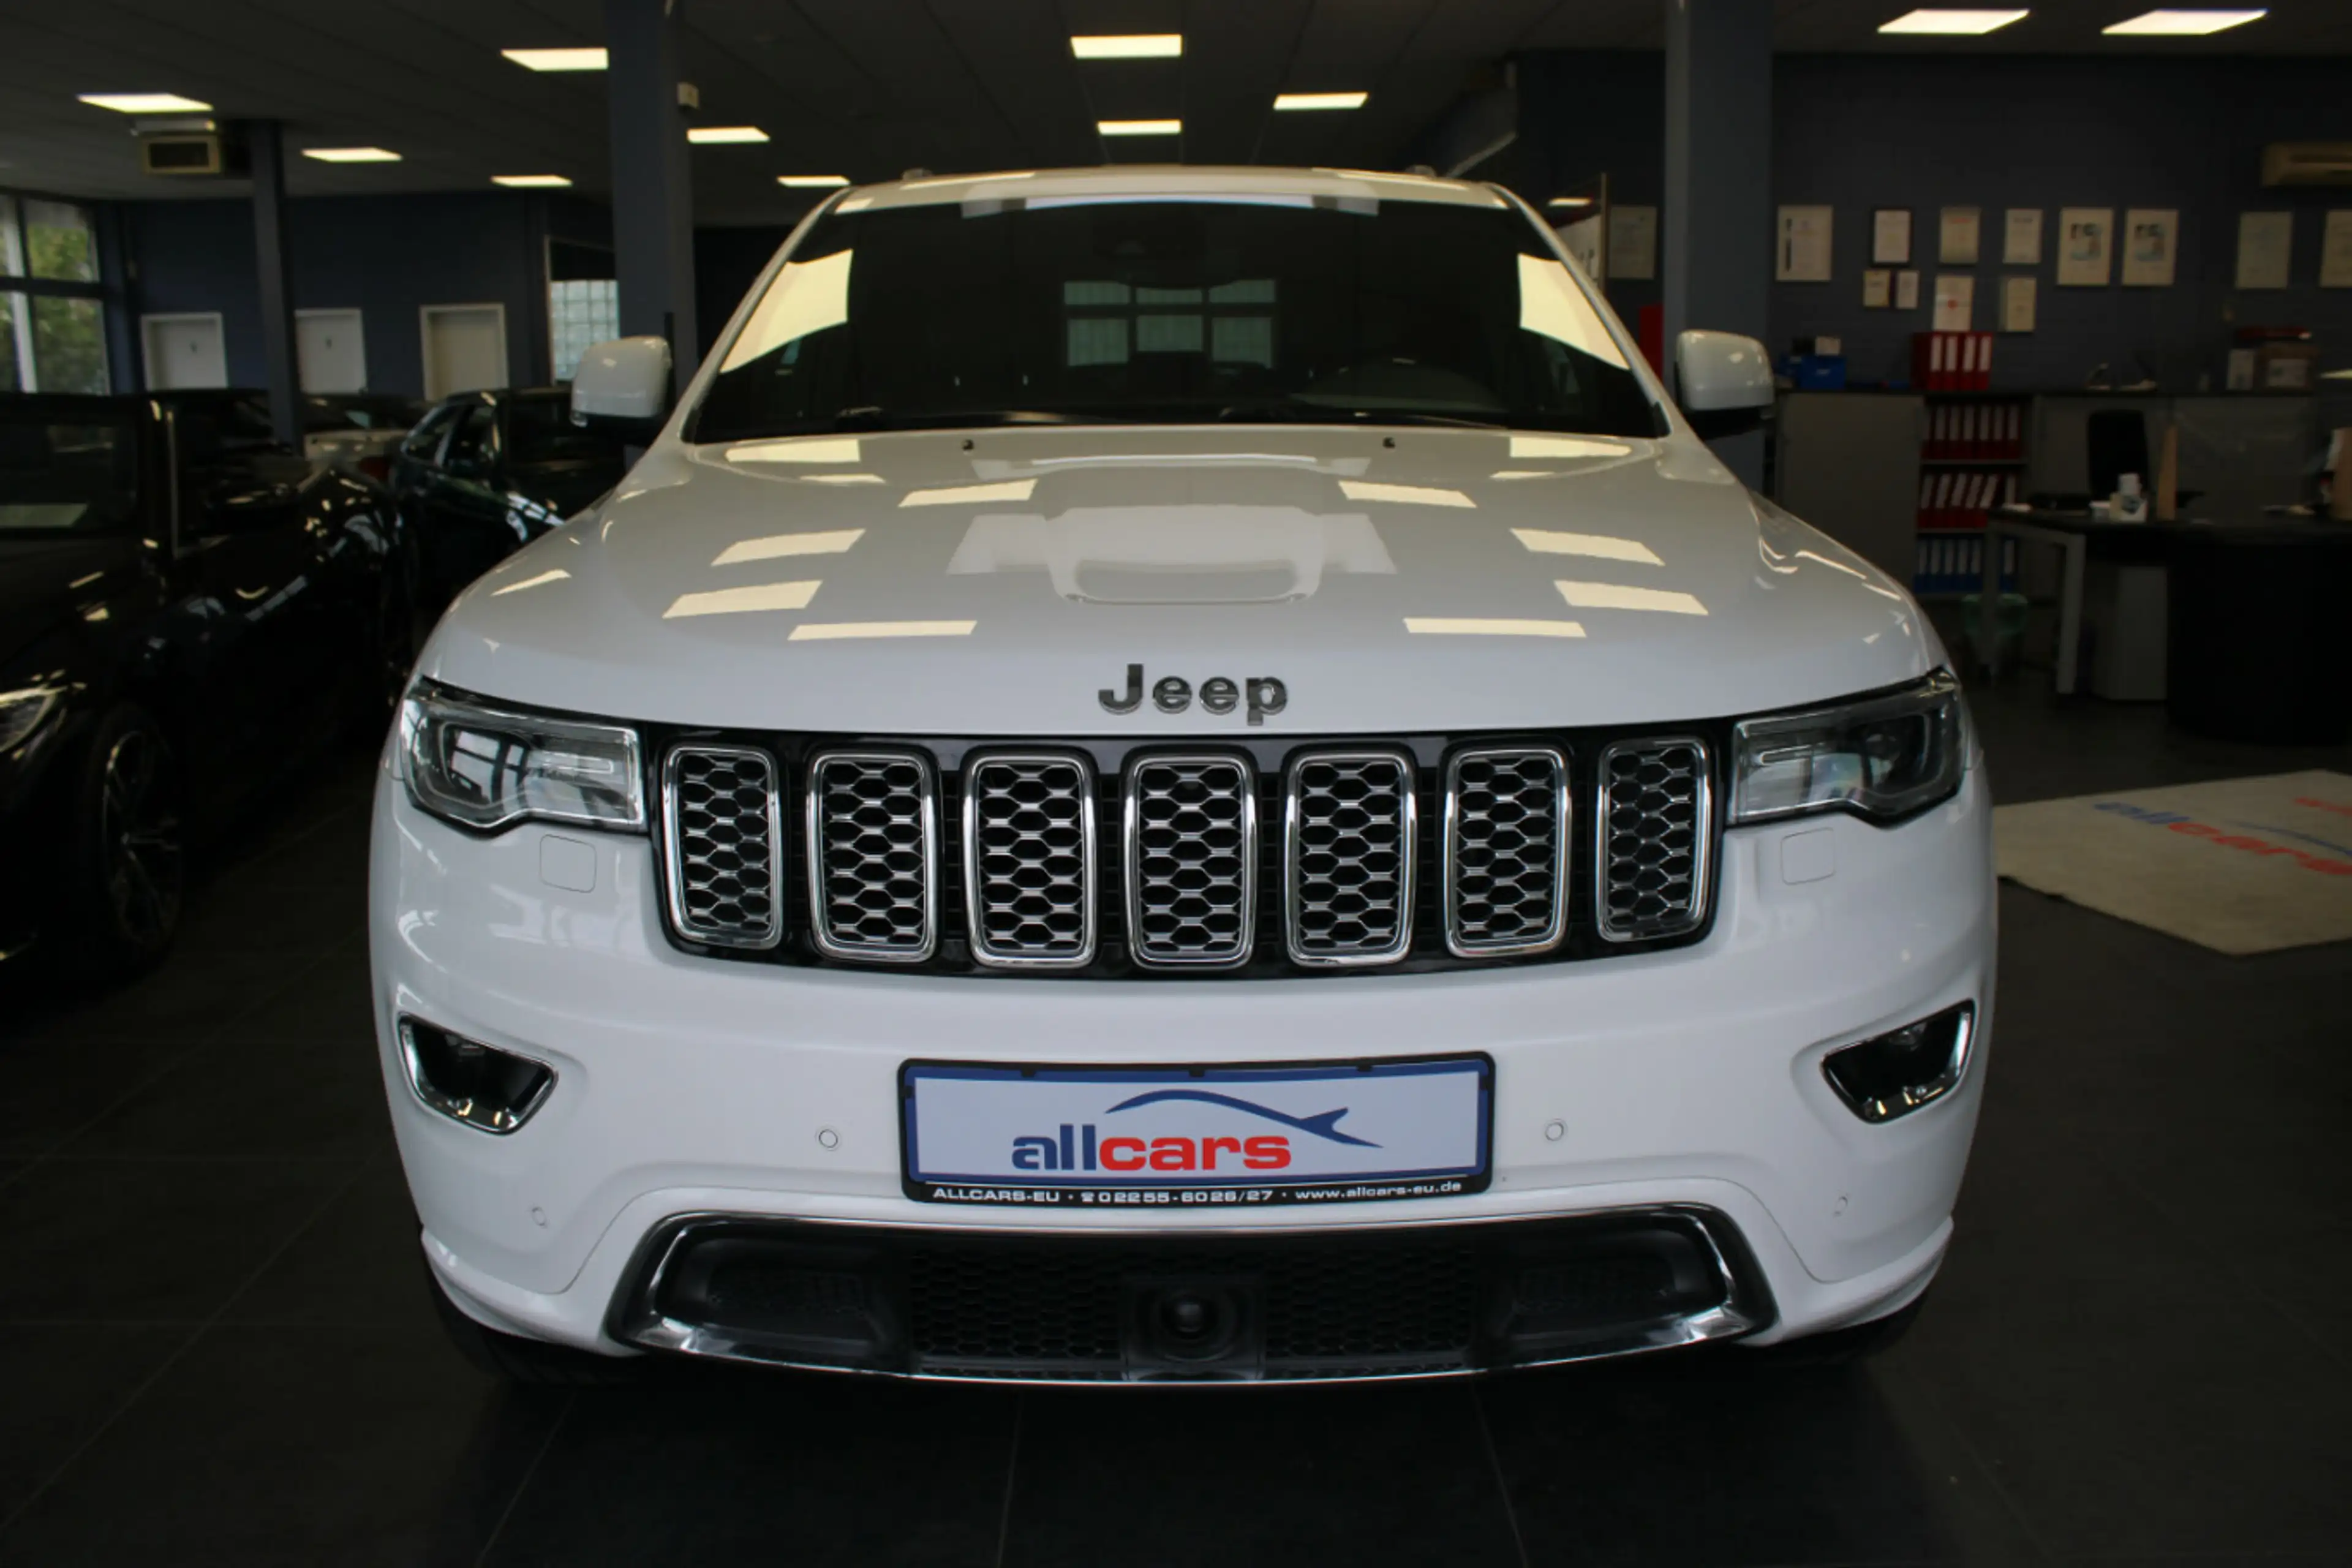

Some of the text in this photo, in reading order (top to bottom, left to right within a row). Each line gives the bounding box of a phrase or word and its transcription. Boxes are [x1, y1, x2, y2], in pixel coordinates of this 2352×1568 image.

[1098, 663, 1287, 726] Jeep
[1011, 1123, 1292, 1171] allcars
[1294, 1180, 1462, 1200] www.allcars-eu.de
